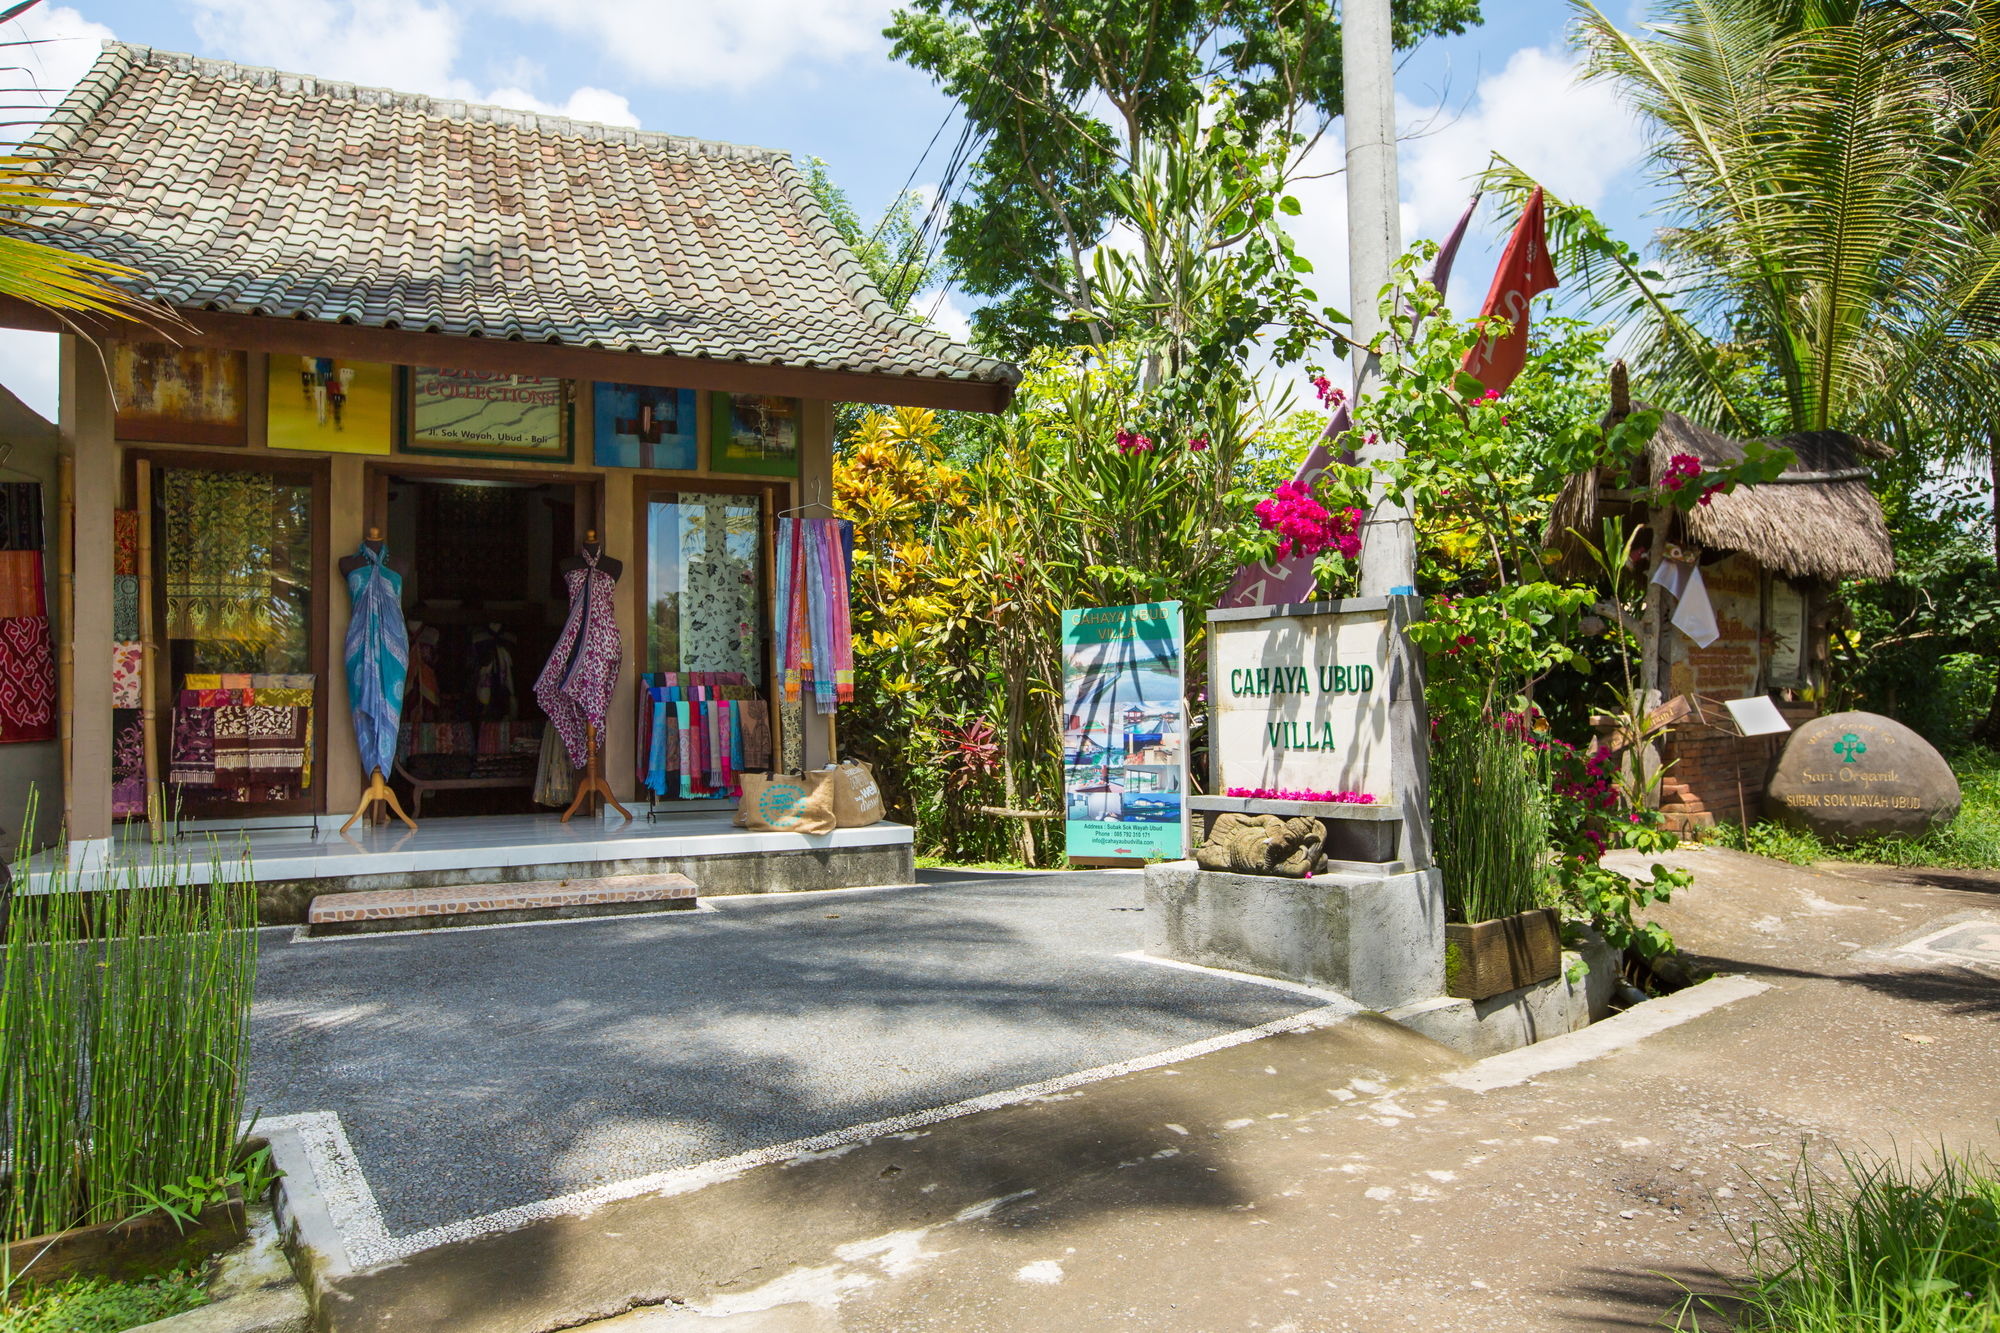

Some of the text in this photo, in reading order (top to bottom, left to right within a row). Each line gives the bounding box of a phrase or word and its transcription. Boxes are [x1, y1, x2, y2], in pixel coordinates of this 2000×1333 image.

[424, 382, 555, 405] COLLECTIONS
[428, 428, 439, 436] Jl.
[441, 429, 458, 437] Sok
[460, 431, 495, 441] Wayah,
[497, 432, 522, 442] Ubud
[531, 434, 549, 443] Bali
[1071, 607, 1169, 626] CAHAYA UBUD
[1098, 627, 1137, 640] VILLA
[1231, 664, 1374, 695] CAHAYA UBUD
[1268, 721, 1335, 750] VILLA
[1802, 767, 1900, 789] Sari Organik
[1786, 793, 1921, 809] SUBAK SOK WAYAH UBUD
[1132, 824, 1149, 832] Wayah
